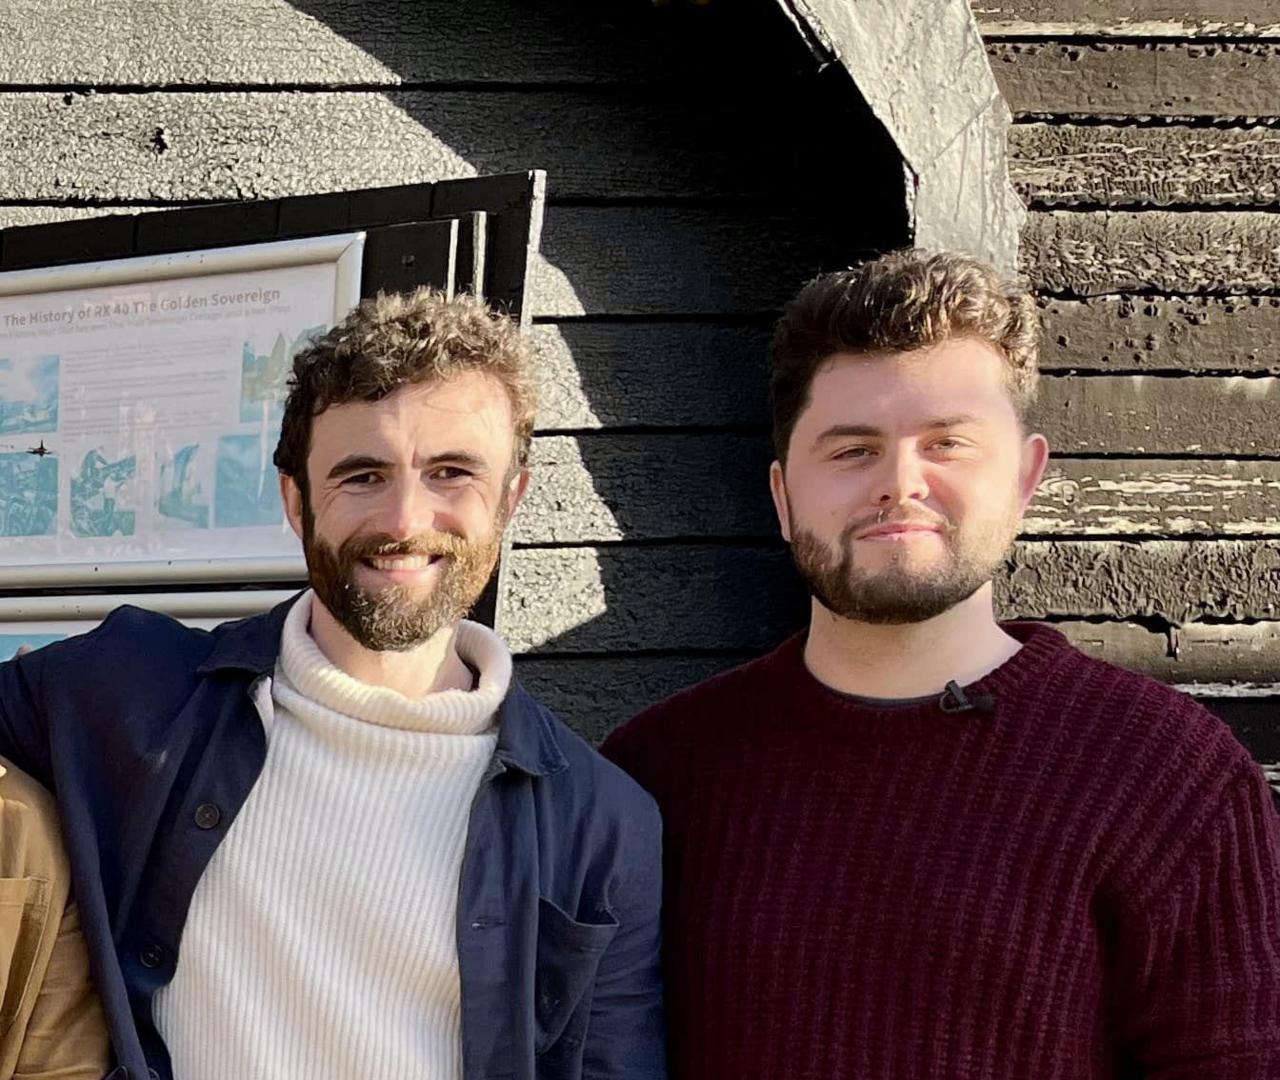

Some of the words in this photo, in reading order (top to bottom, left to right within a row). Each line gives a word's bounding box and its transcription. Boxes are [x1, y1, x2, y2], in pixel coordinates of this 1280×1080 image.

[3, 315, 26, 327] The
[29, 309, 74, 324] History
[78, 306, 91, 320] of
[94, 304, 111, 318] RX
[113, 303, 129, 316] 40
[160, 296, 208, 312] Golden
[211, 287, 280, 305] Sovereign
